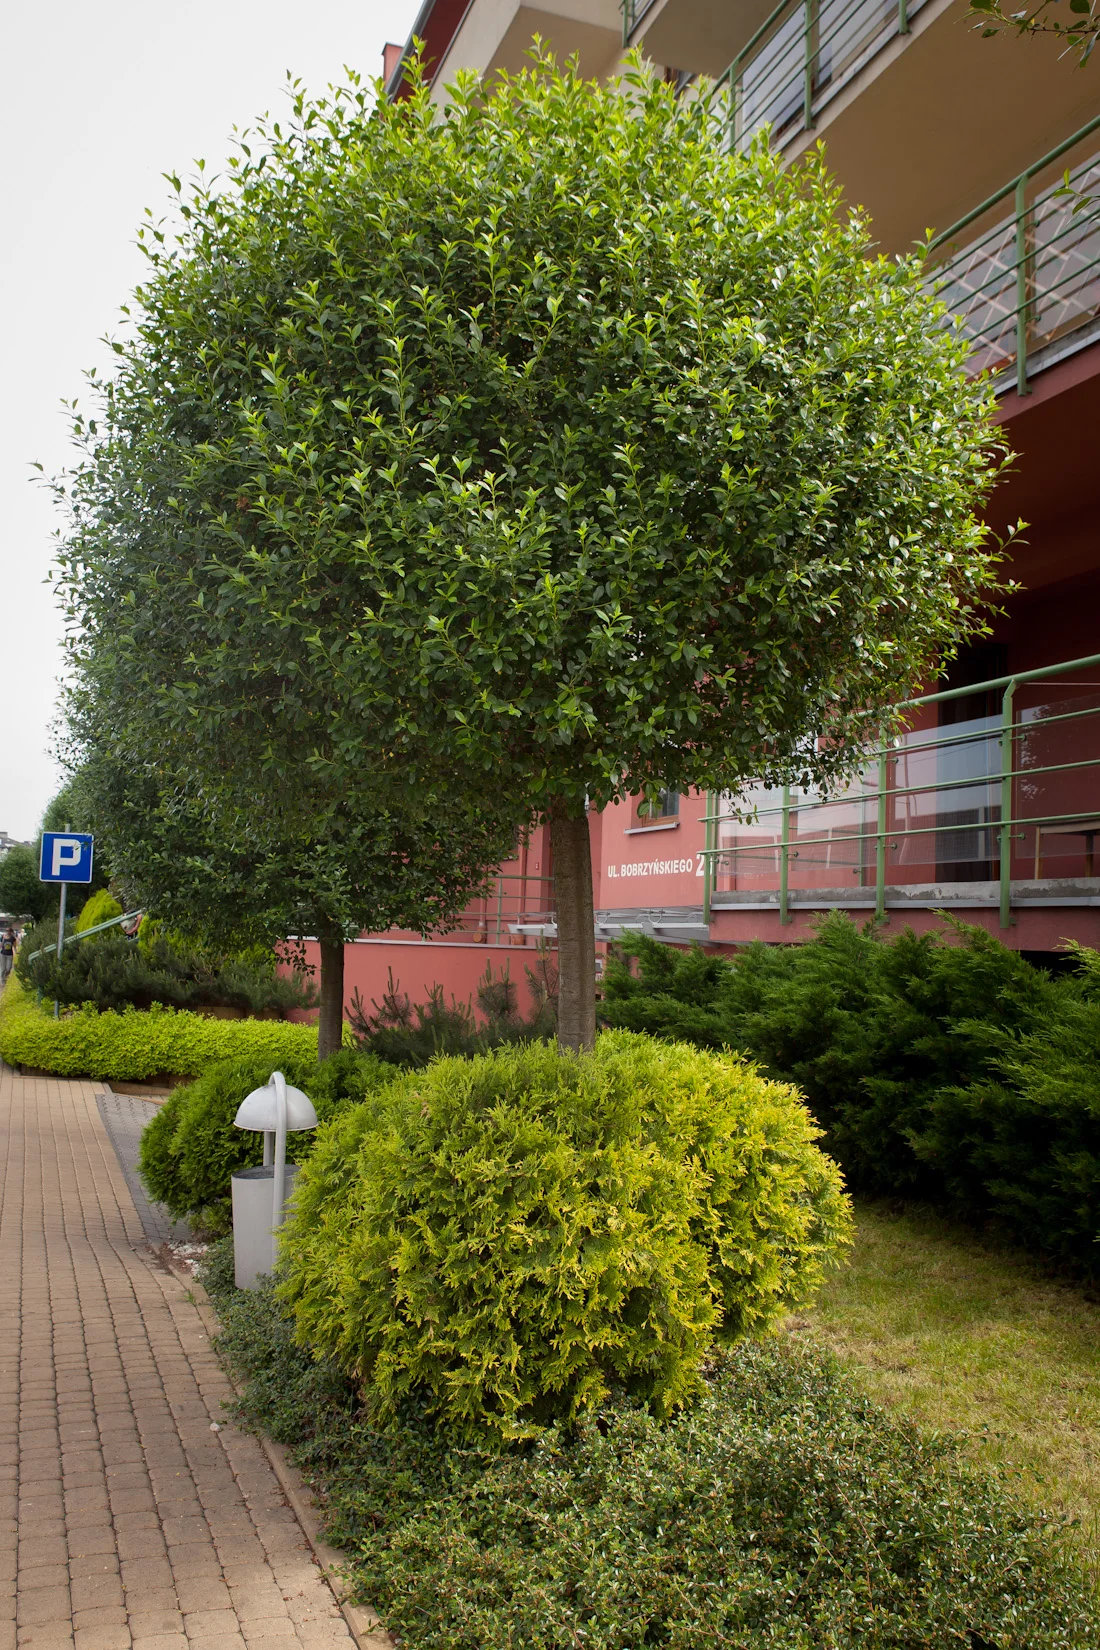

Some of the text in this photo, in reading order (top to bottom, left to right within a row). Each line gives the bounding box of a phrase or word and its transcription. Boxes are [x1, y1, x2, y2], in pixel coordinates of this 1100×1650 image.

[51, 838, 82, 876] P
[607, 865, 620, 878] UL.
[620, 858, 693, 877] BOBRZYŃSKIEGO
